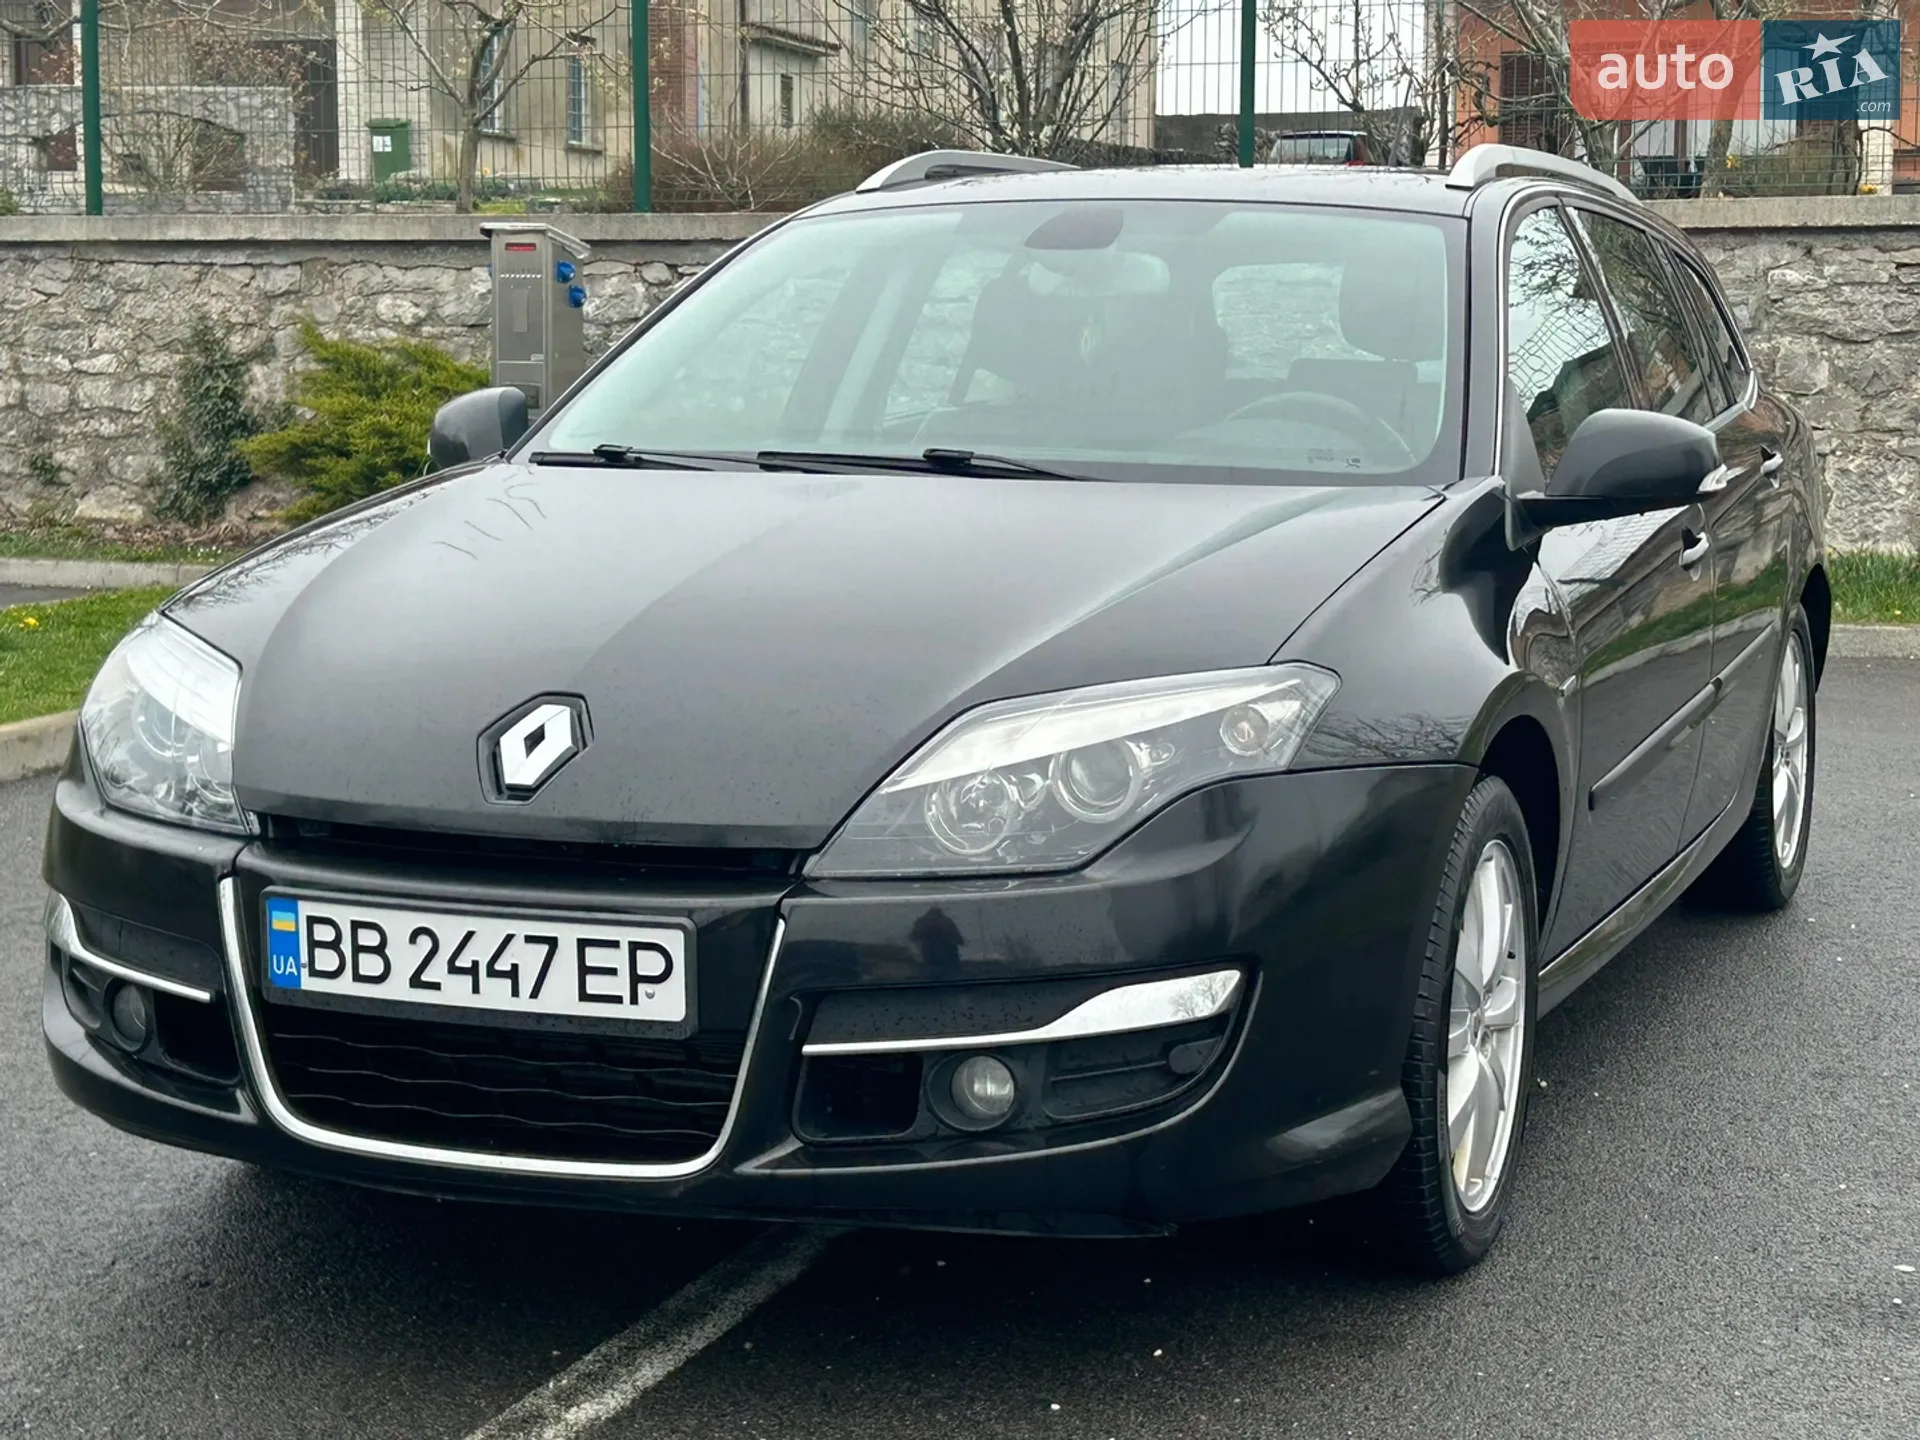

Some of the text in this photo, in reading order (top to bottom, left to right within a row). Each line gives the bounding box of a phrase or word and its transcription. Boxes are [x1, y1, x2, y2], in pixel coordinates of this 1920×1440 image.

[272, 953, 298, 977] UA
[305, 914, 674, 1006] BB 2447 EP
